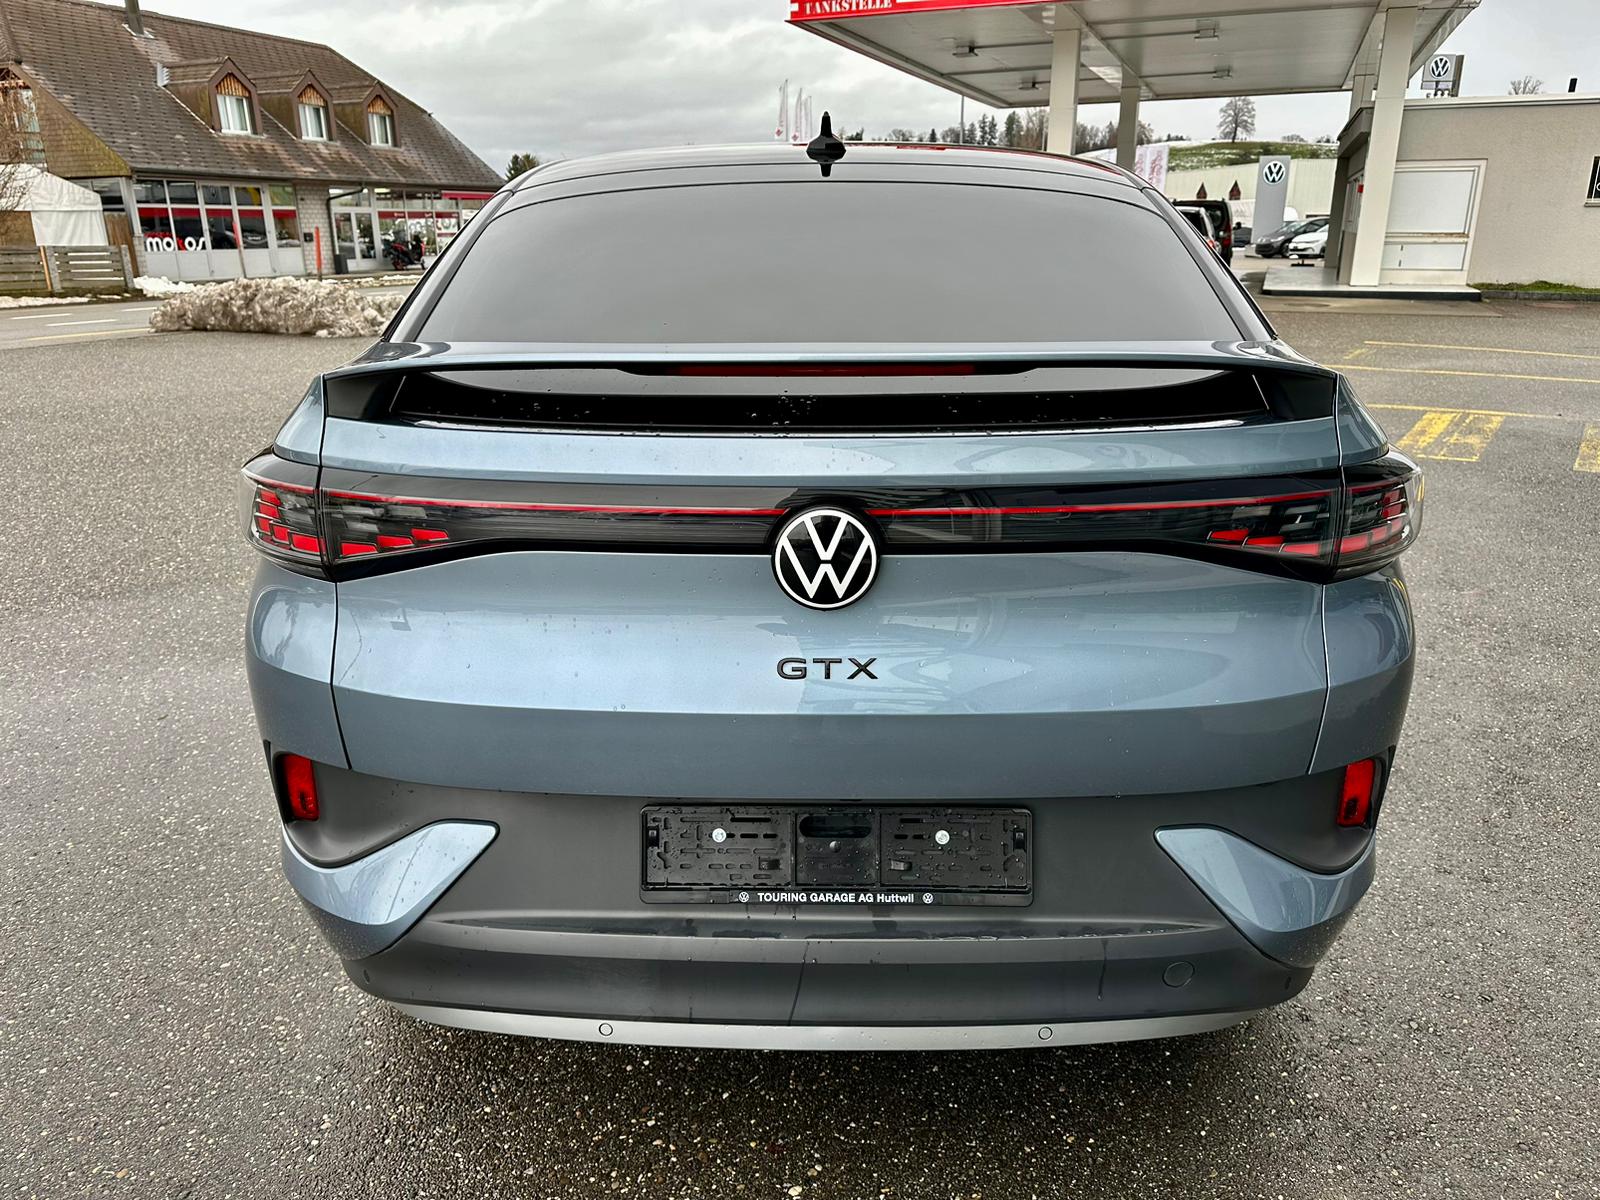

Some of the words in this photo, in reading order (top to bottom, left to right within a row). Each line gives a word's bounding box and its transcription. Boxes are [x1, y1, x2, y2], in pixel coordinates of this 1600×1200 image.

[805, 0, 892, 14] TANKSTELLE
[776, 510, 876, 607] VW
[776, 657, 878, 680] GTX
[757, 892, 807, 902] TOURING
[809, 892, 856, 903] GARAGE
[858, 893, 874, 903] AG
[877, 893, 914, 903] Huttwil
